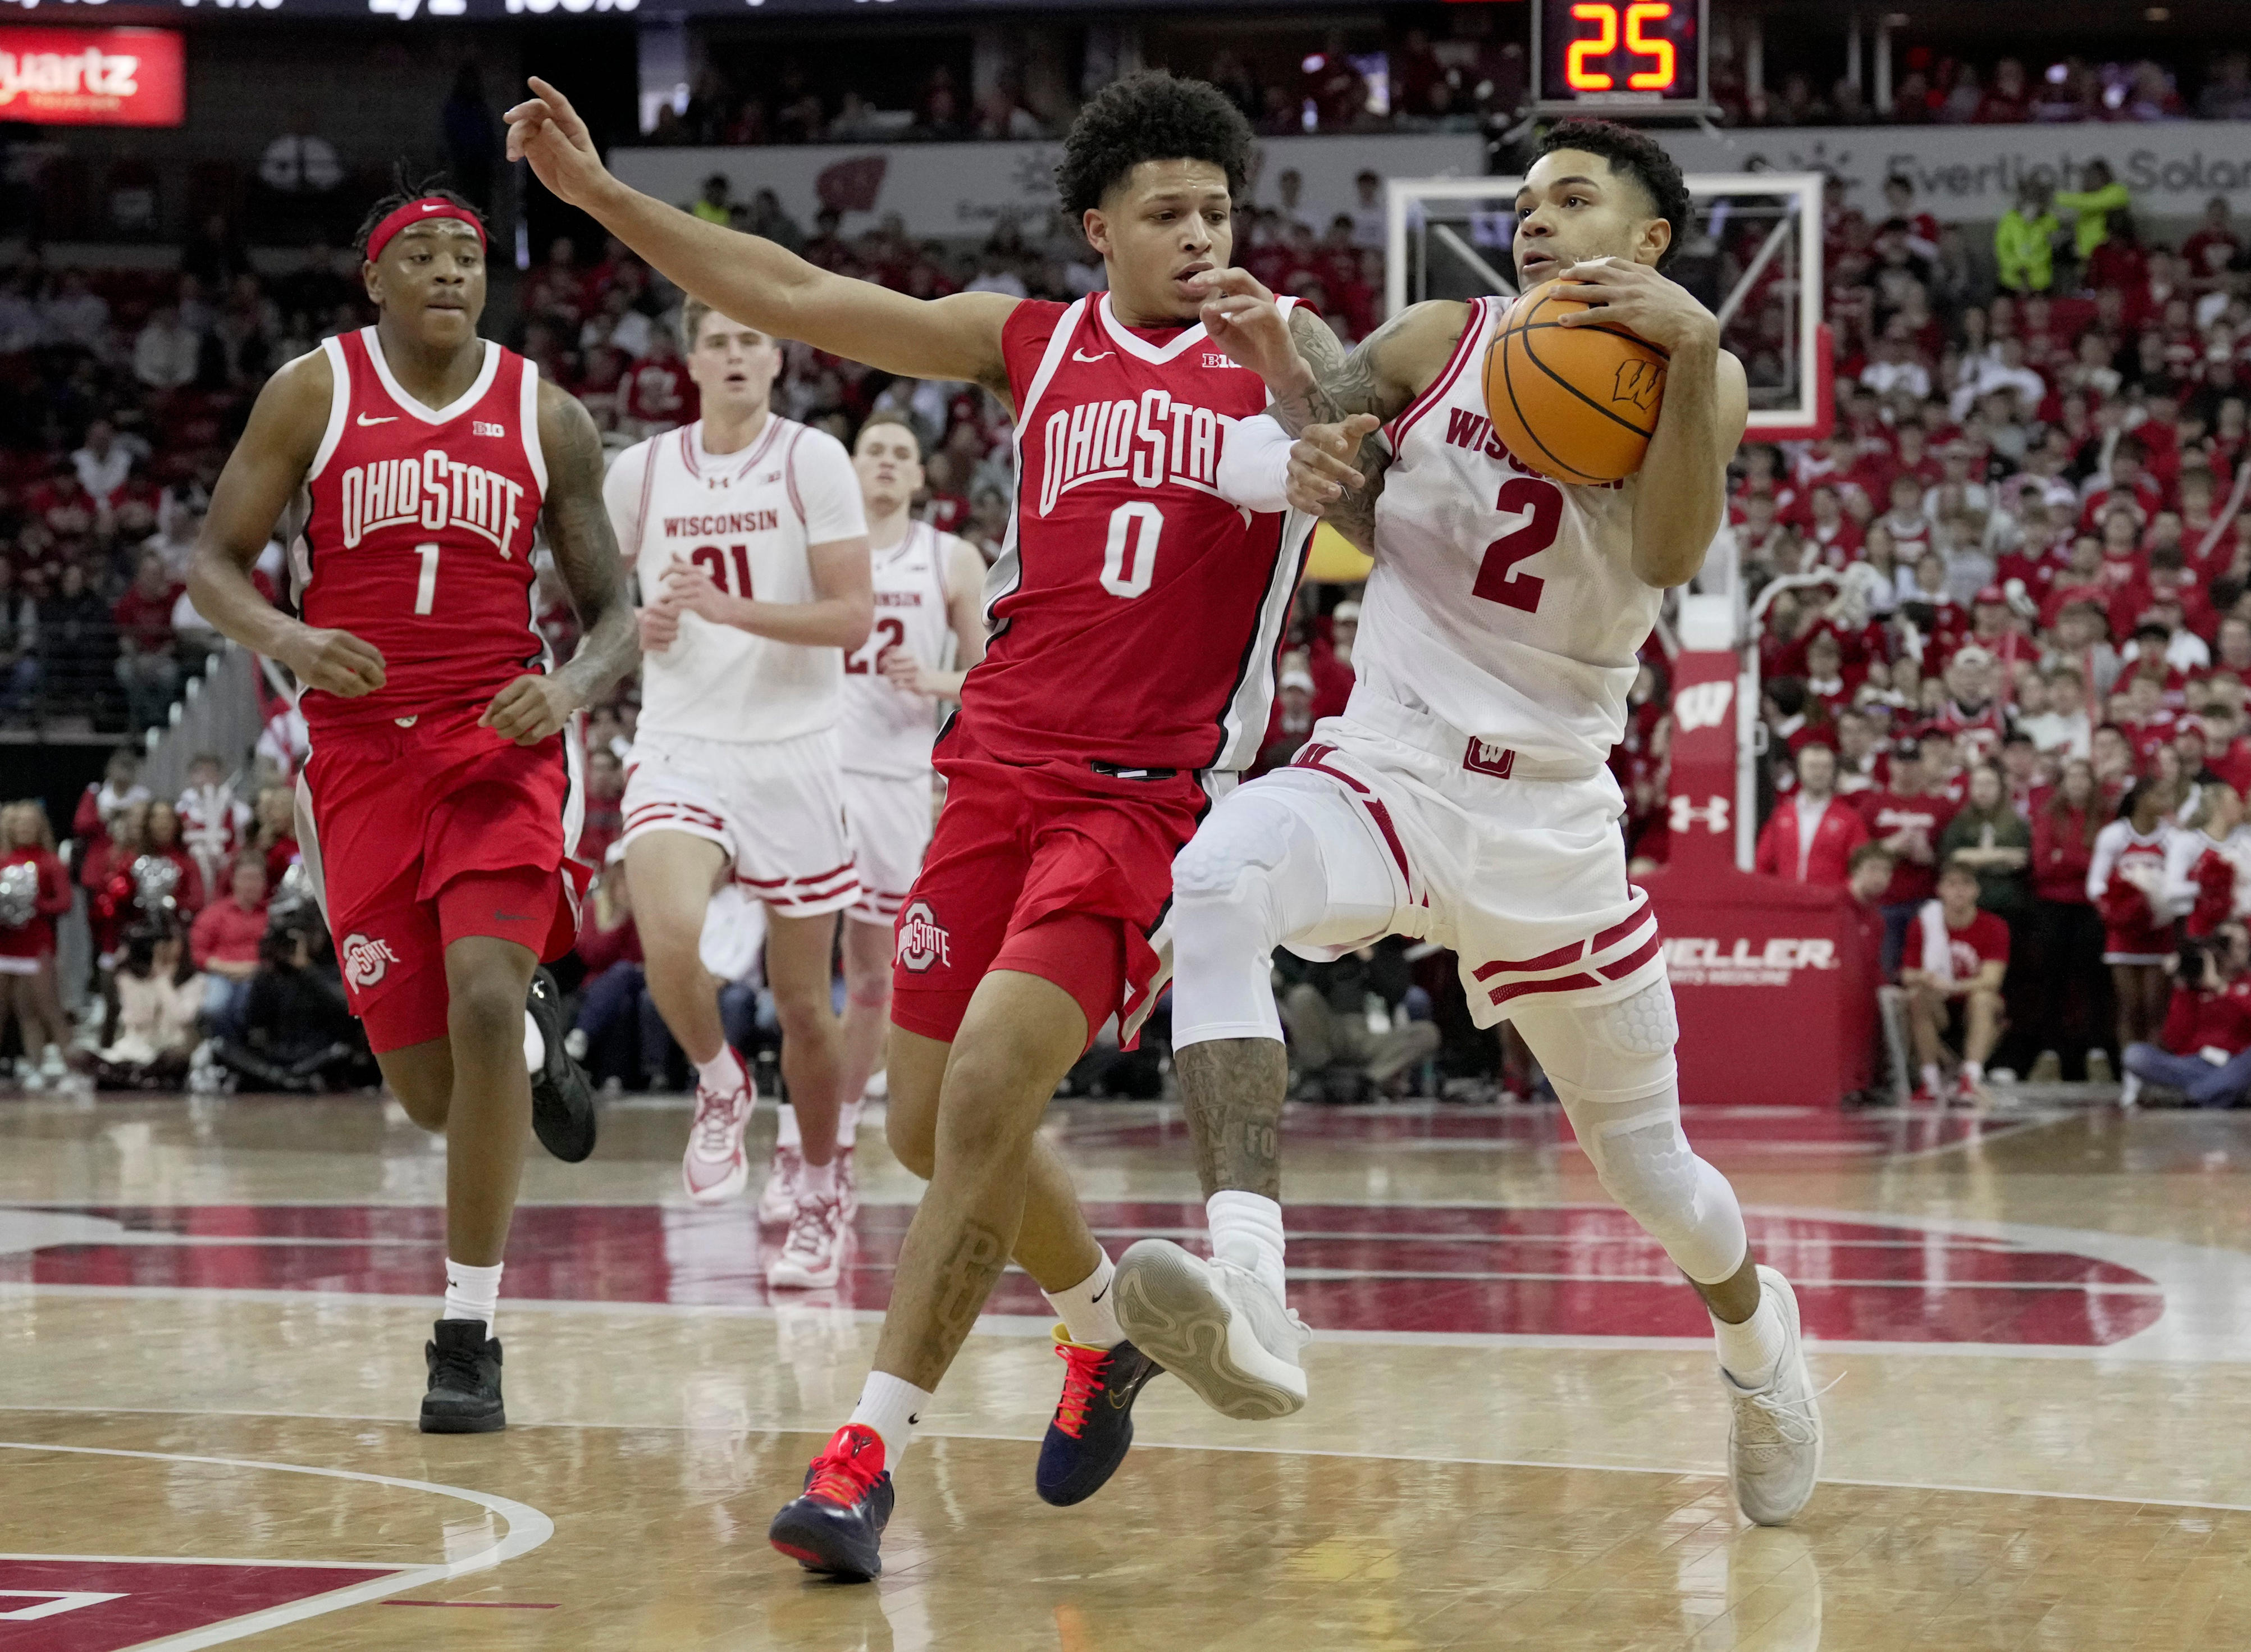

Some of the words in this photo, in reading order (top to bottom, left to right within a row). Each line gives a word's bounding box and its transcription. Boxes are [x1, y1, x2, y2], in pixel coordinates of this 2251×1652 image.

[0, 46, 139, 105] uartz
[1565, 3, 1676, 91] 25
[664, 509, 778, 537] WISCONSIN
[1099, 500, 1164, 599] 0
[1472, 477, 1563, 613] 2
[414, 542, 439, 615] 1
